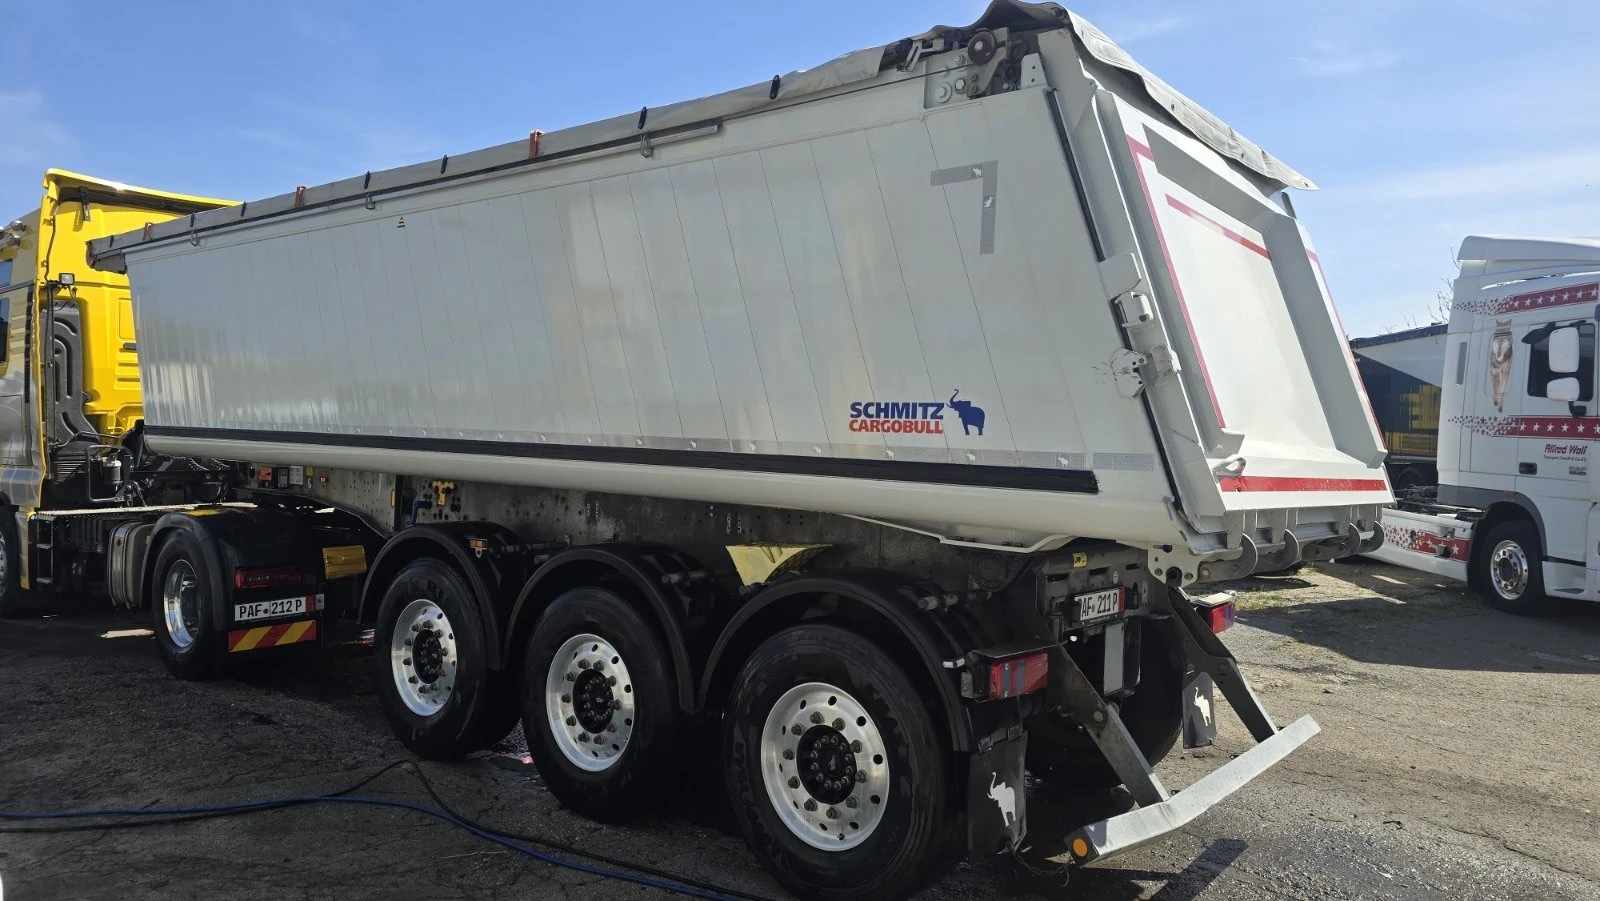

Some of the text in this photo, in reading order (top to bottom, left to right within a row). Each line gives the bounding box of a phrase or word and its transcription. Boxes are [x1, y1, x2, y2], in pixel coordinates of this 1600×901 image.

[850, 402, 944, 419] SCHMITZ
[849, 420, 943, 434] CARGOBULL
[239, 603, 262, 618] PAF
